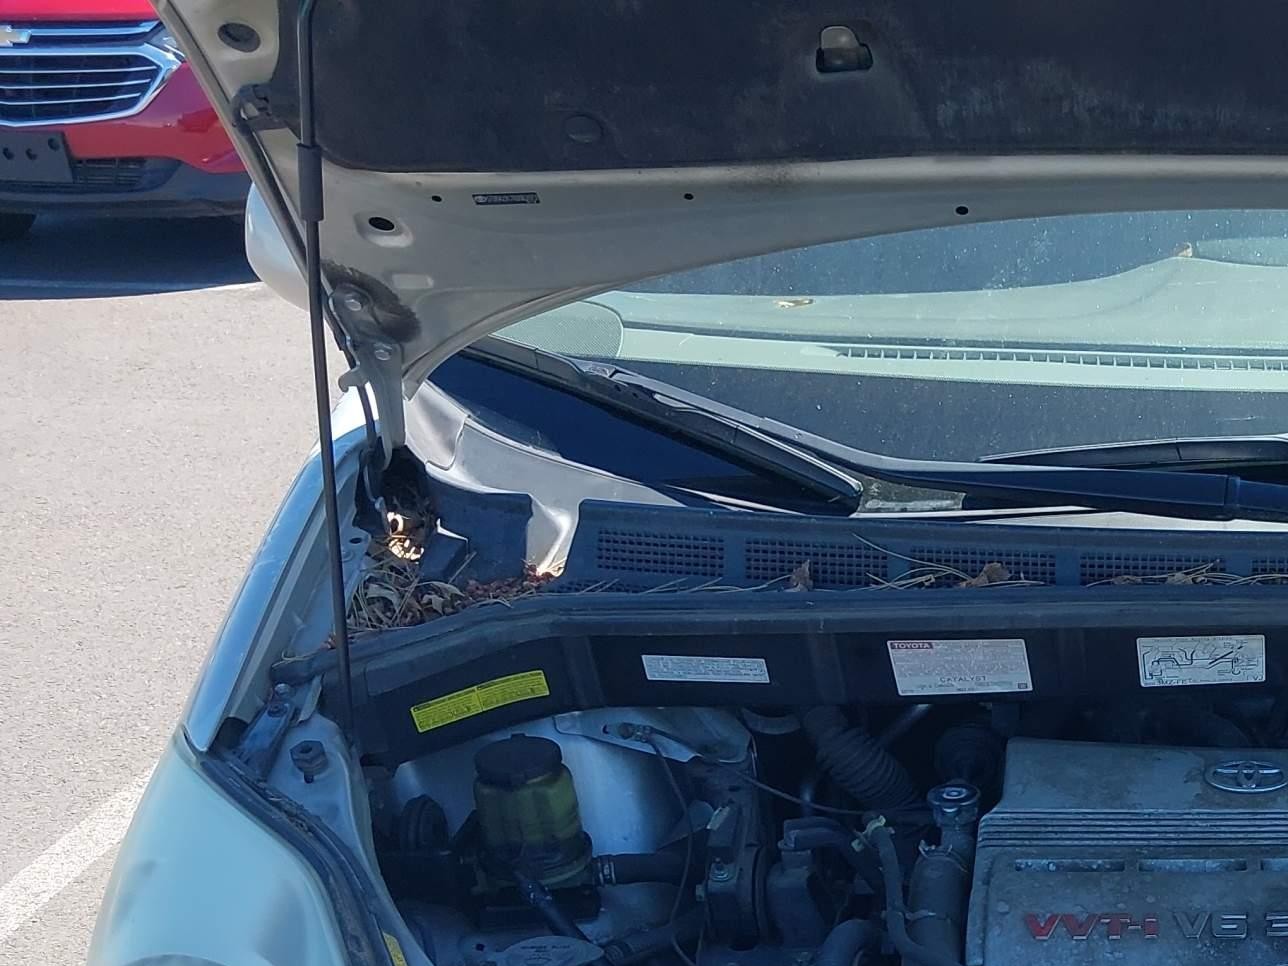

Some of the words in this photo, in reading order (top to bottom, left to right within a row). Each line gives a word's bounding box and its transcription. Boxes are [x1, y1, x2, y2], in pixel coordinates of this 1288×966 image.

[892, 642, 931, 650] TOYOTA
[939, 675, 986, 683] CATALYST
[1173, 911, 1247, 939] V6
